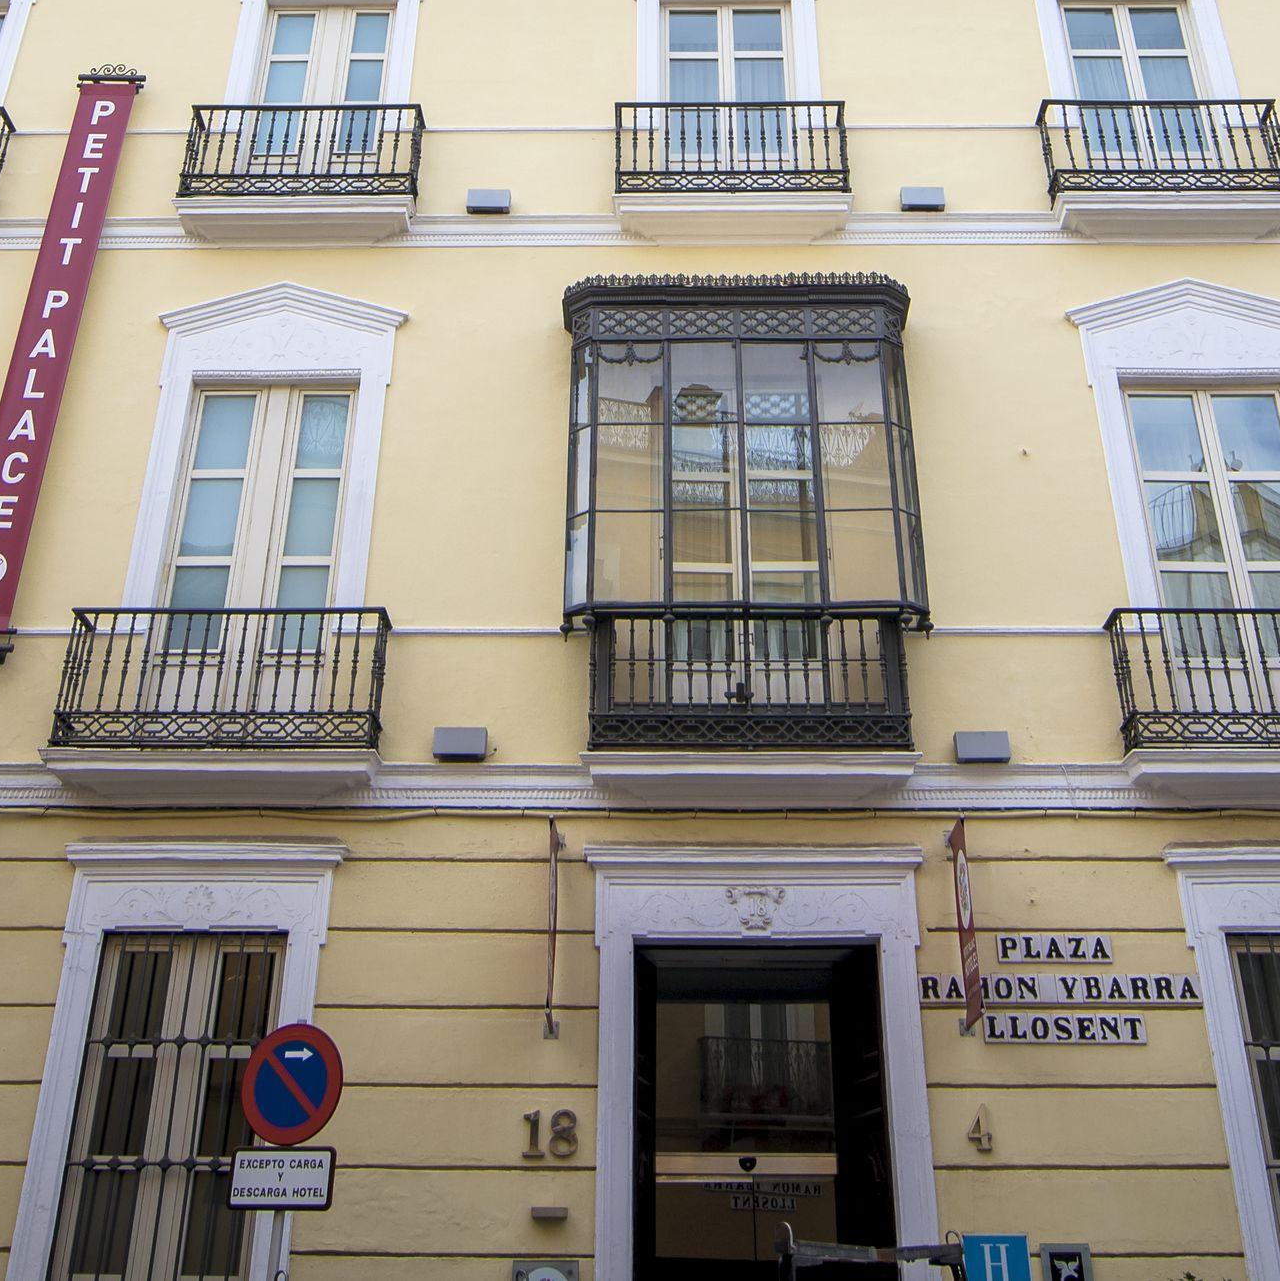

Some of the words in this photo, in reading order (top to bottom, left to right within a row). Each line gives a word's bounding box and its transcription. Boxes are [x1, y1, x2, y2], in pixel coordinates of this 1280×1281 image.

[60, 100, 116, 266] PETIT
[1000, 936, 1110, 959] PLAZA
[1059, 976, 1199, 1000] YBARRA
[986, 1015, 1141, 1040] LLOSENT
[522, 1108, 579, 1159] 18
[967, 1102, 993, 1152] 4
[239, 1159, 285, 1169] EXCEPTO
[289, 1159, 324, 1169] CARGA
[277, 1172, 284, 1182] Y
[232, 1187, 287, 1198] DESCARGA
[292, 1187, 324, 1198] HOTEL
[980, 1243, 1010, 1281] H
